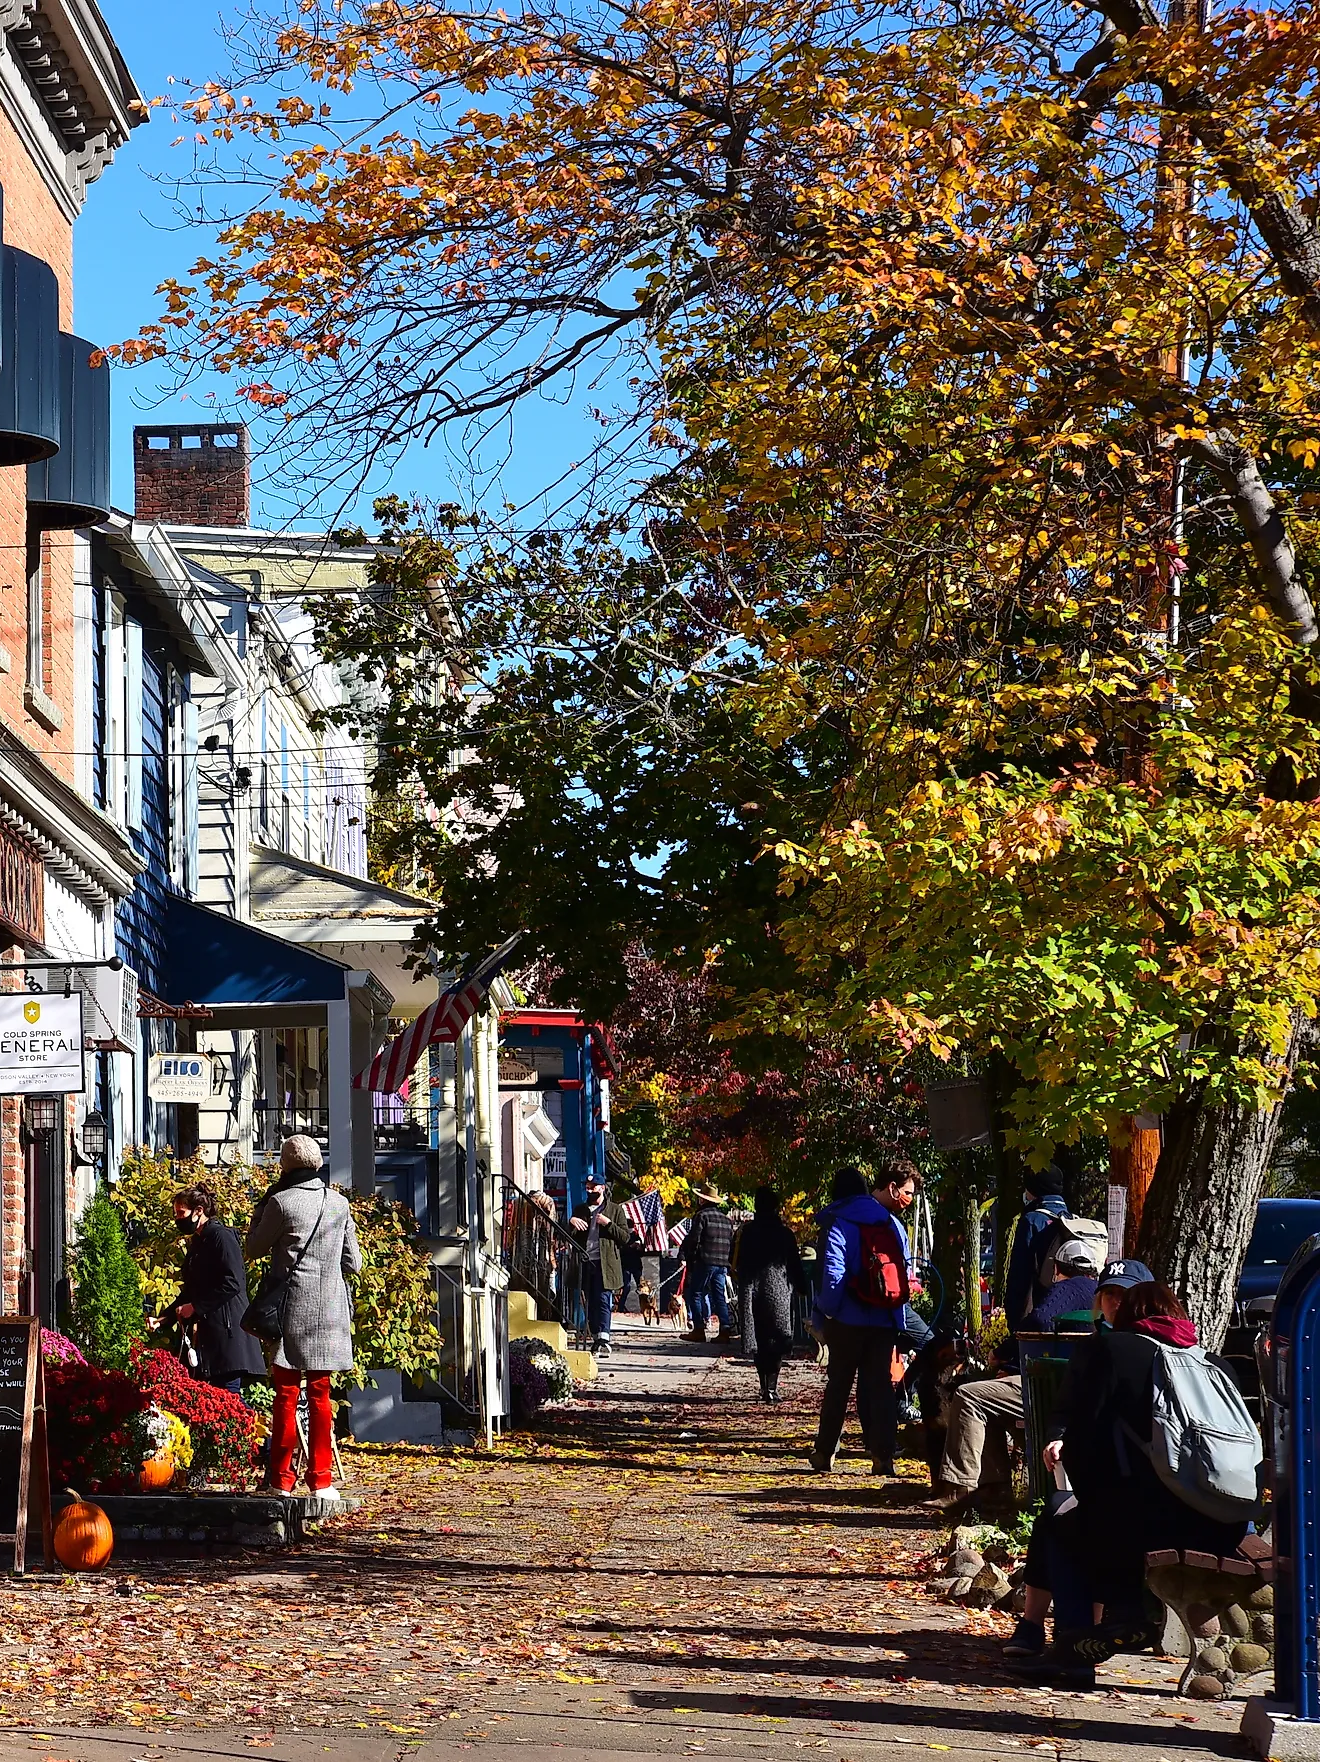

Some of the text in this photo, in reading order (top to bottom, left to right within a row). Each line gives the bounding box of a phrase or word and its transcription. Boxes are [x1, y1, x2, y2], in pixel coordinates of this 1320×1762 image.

[4, 1030, 62, 1039] COLD SPRING
[498, 1072, 532, 1081] OUCHON
[10, 1336, 26, 1344] YOU
[2, 1347, 16, 1355] WE
[2, 1357, 24, 1367] YOUR
